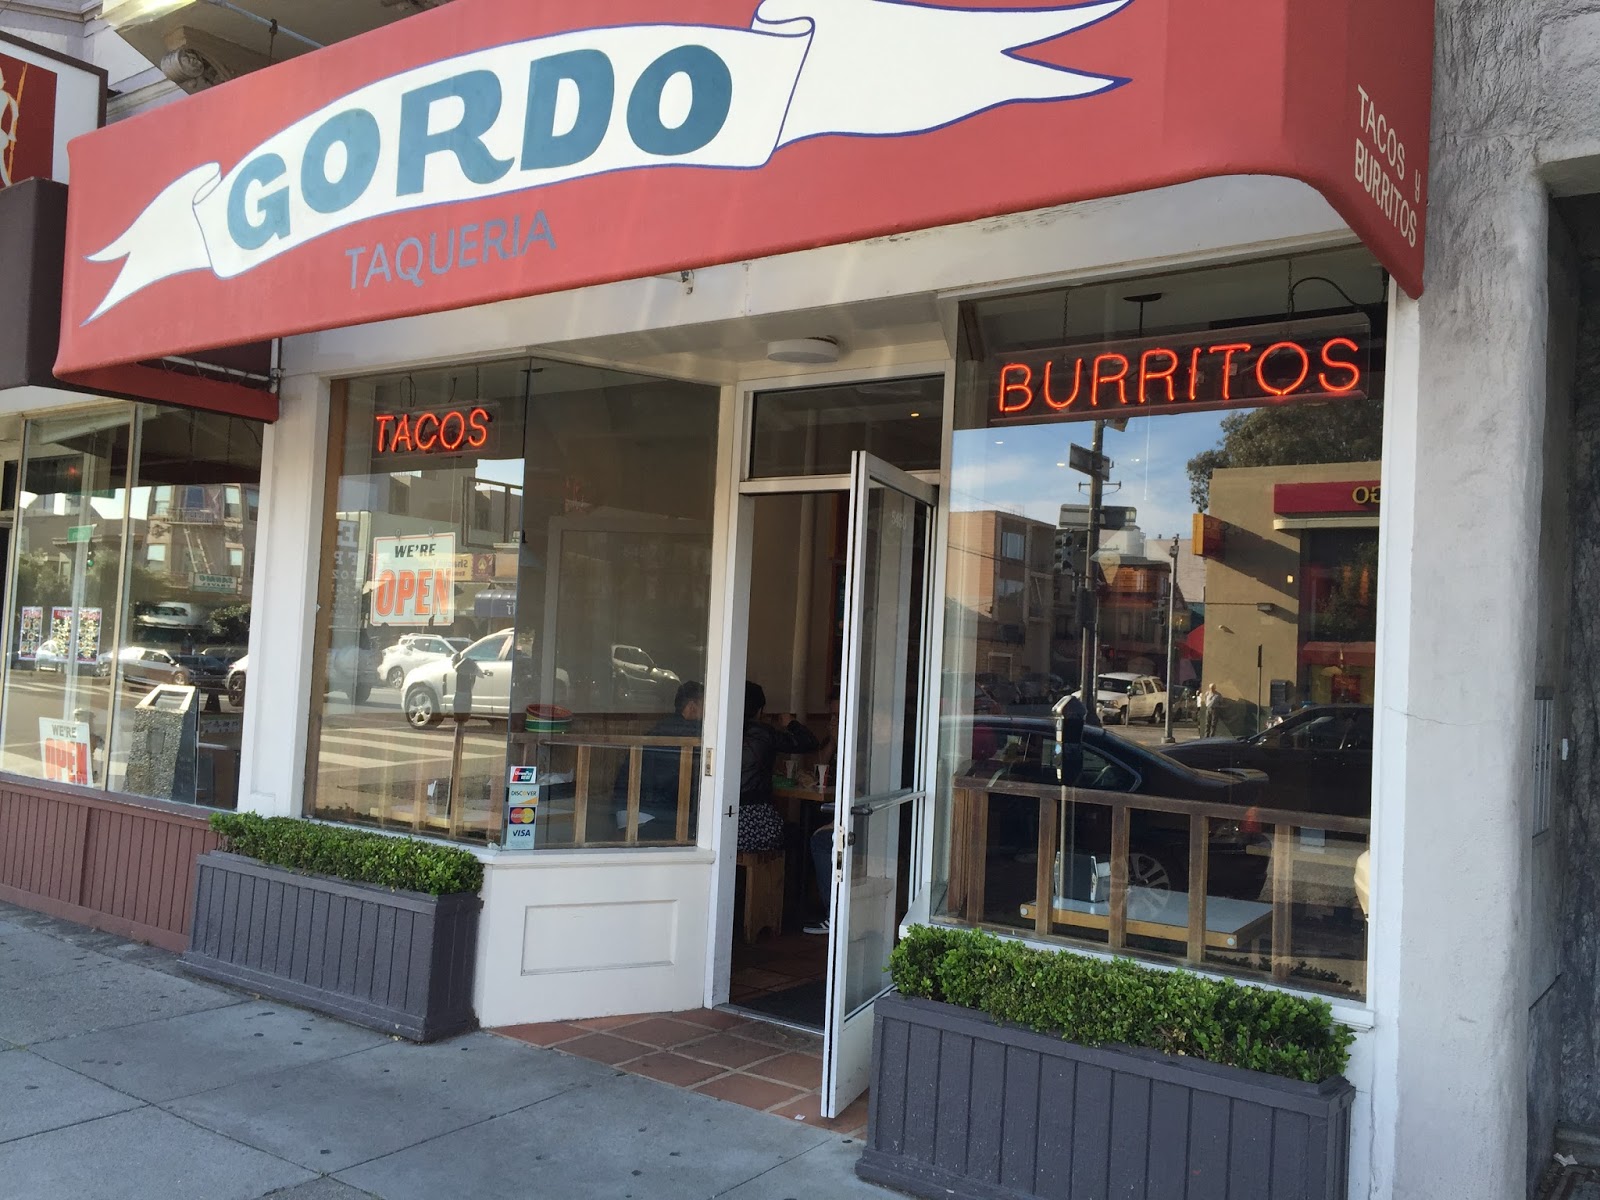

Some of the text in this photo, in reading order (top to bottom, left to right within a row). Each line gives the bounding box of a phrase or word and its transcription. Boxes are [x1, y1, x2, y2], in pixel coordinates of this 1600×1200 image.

[226, 45, 732, 250] GORDO
[1357, 84, 1405, 181] TACOS
[1355, 138, 1417, 248] BURRITOS
[345, 209, 556, 290] TAQUERIA
[999, 337, 1360, 413] BURRITOS
[375, 408, 489, 453] TACOS
[394, 543, 436, 558] WE'RE
[374, 568, 449, 617] OPEN
[51, 724, 77, 738] WE'RE
[45, 737, 87, 785] OPEN
[512, 829, 531, 837] VISA
